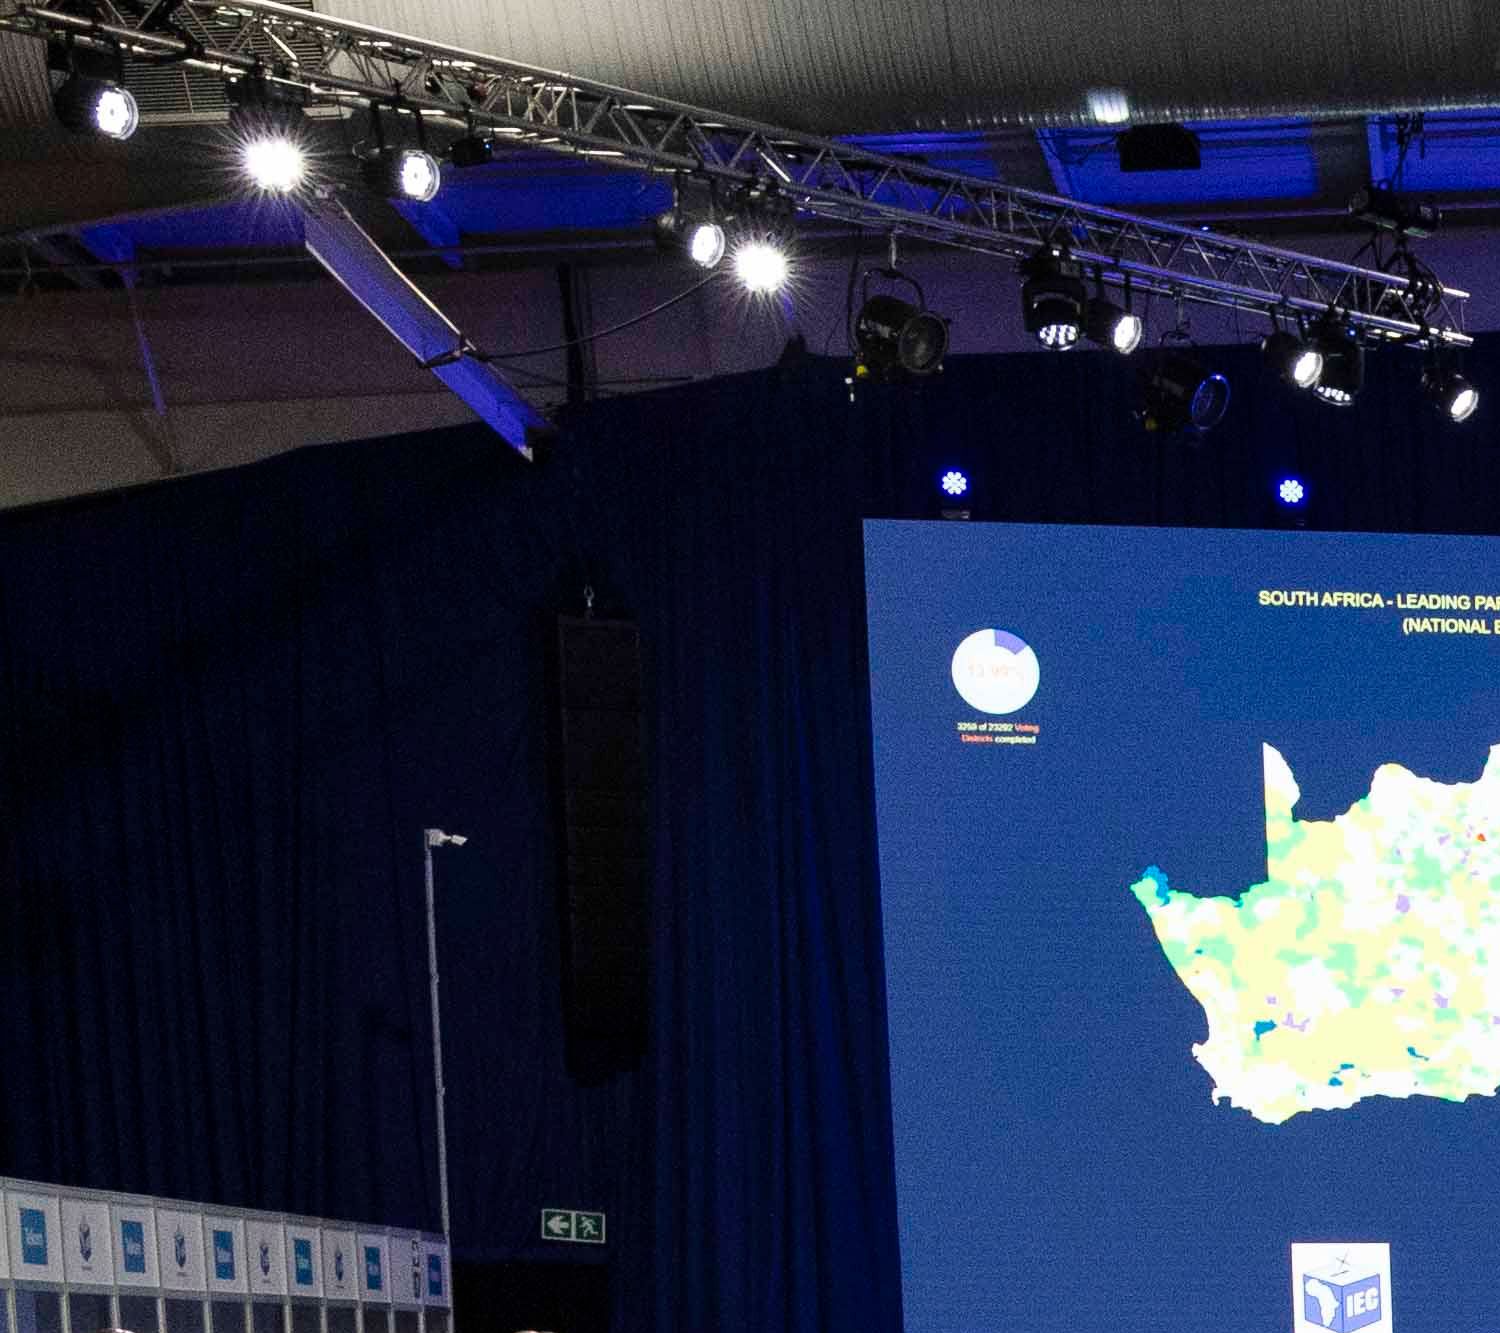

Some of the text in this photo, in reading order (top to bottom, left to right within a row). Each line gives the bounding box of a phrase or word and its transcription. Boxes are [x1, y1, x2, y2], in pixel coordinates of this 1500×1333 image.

[1259, 591, 1318, 606] SOUTH
[1321, 592, 1384, 607] AFRICA
[1397, 594, 1471, 609] LEADING
[1403, 618, 1491, 634] (NATIONAL
[1347, 1287, 1378, 1318] IEC
